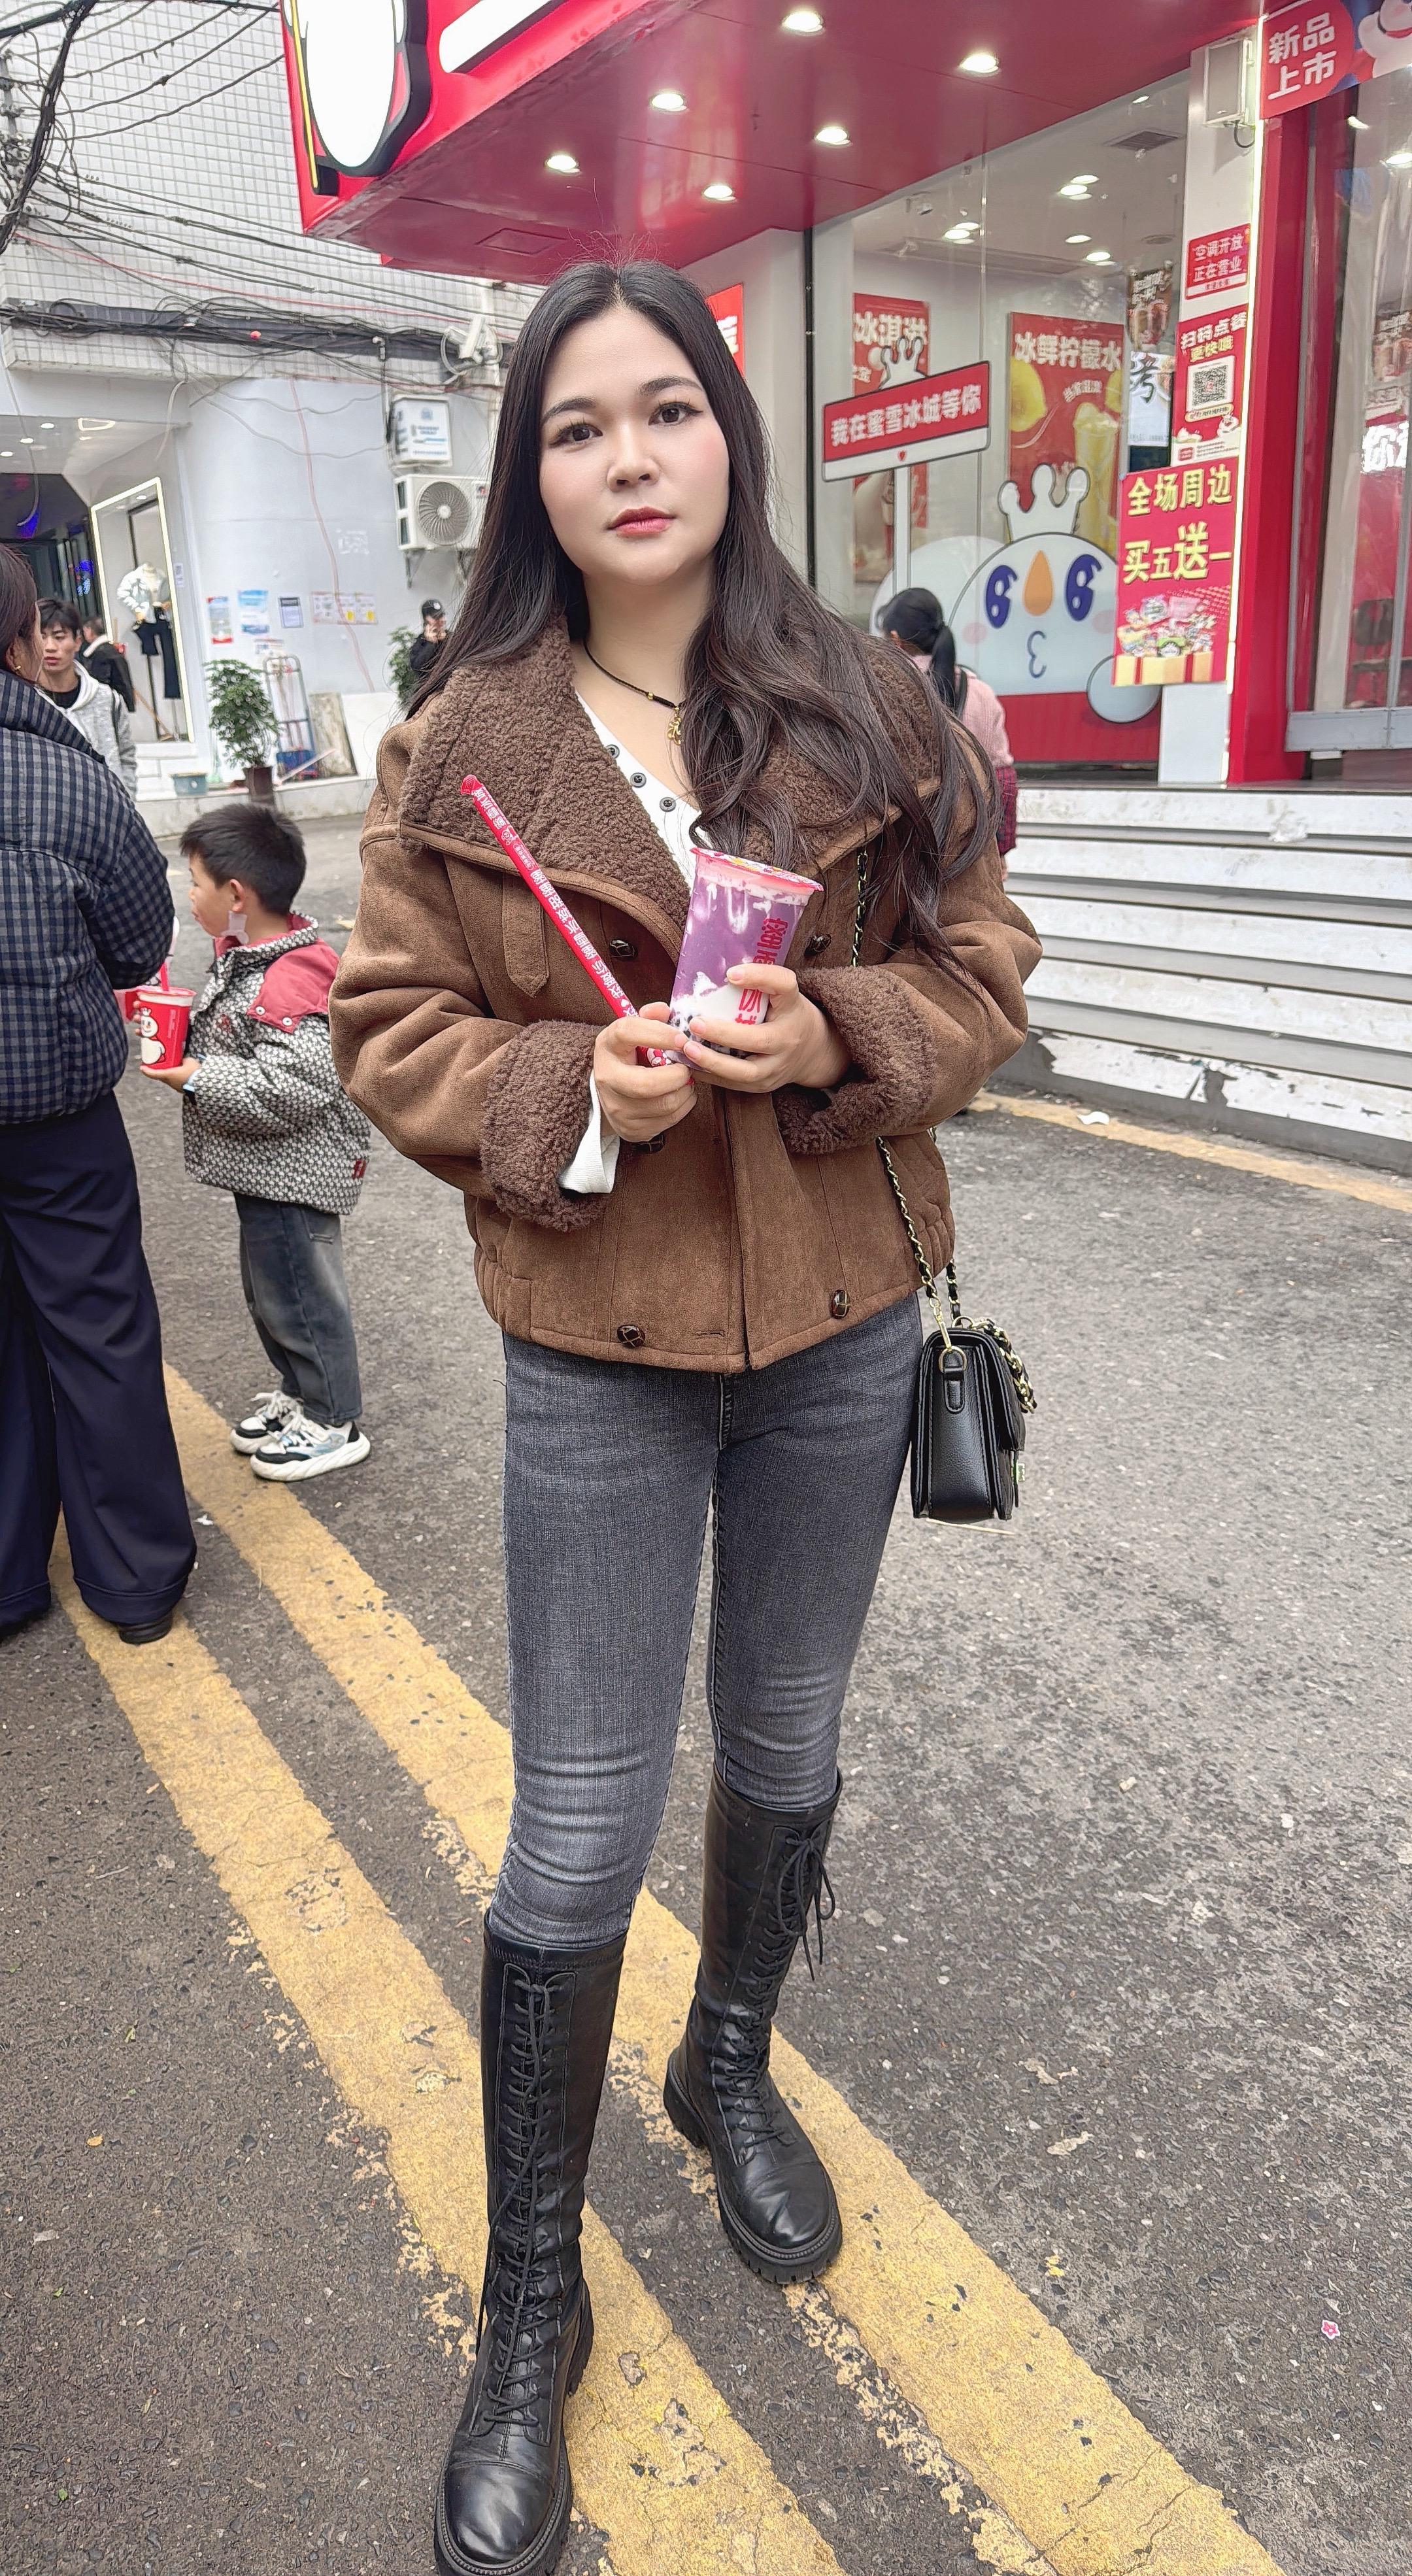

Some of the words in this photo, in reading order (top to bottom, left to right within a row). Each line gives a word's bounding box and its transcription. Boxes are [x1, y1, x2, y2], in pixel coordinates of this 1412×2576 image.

[1268, 12, 1335, 63] 新品
[1268, 50, 1337, 99] 上市
[1192, 233, 1244, 261] 空调开放
[1193, 255, 1242, 282] 正在营业
[1015, 331, 1122, 371] 冰鲜柠檬水
[1180, 311, 1247, 350] 扫码点餐
[830, 383, 982, 447] 我在蜜雪冰城等你
[1128, 463, 1233, 517] 全场周边
[1122, 520, 1232, 585] 买五送一
[472, 785, 508, 830] 蜜雪冰城
[530, 867, 597, 961] 蜜雪冰城甜蜜蜜
